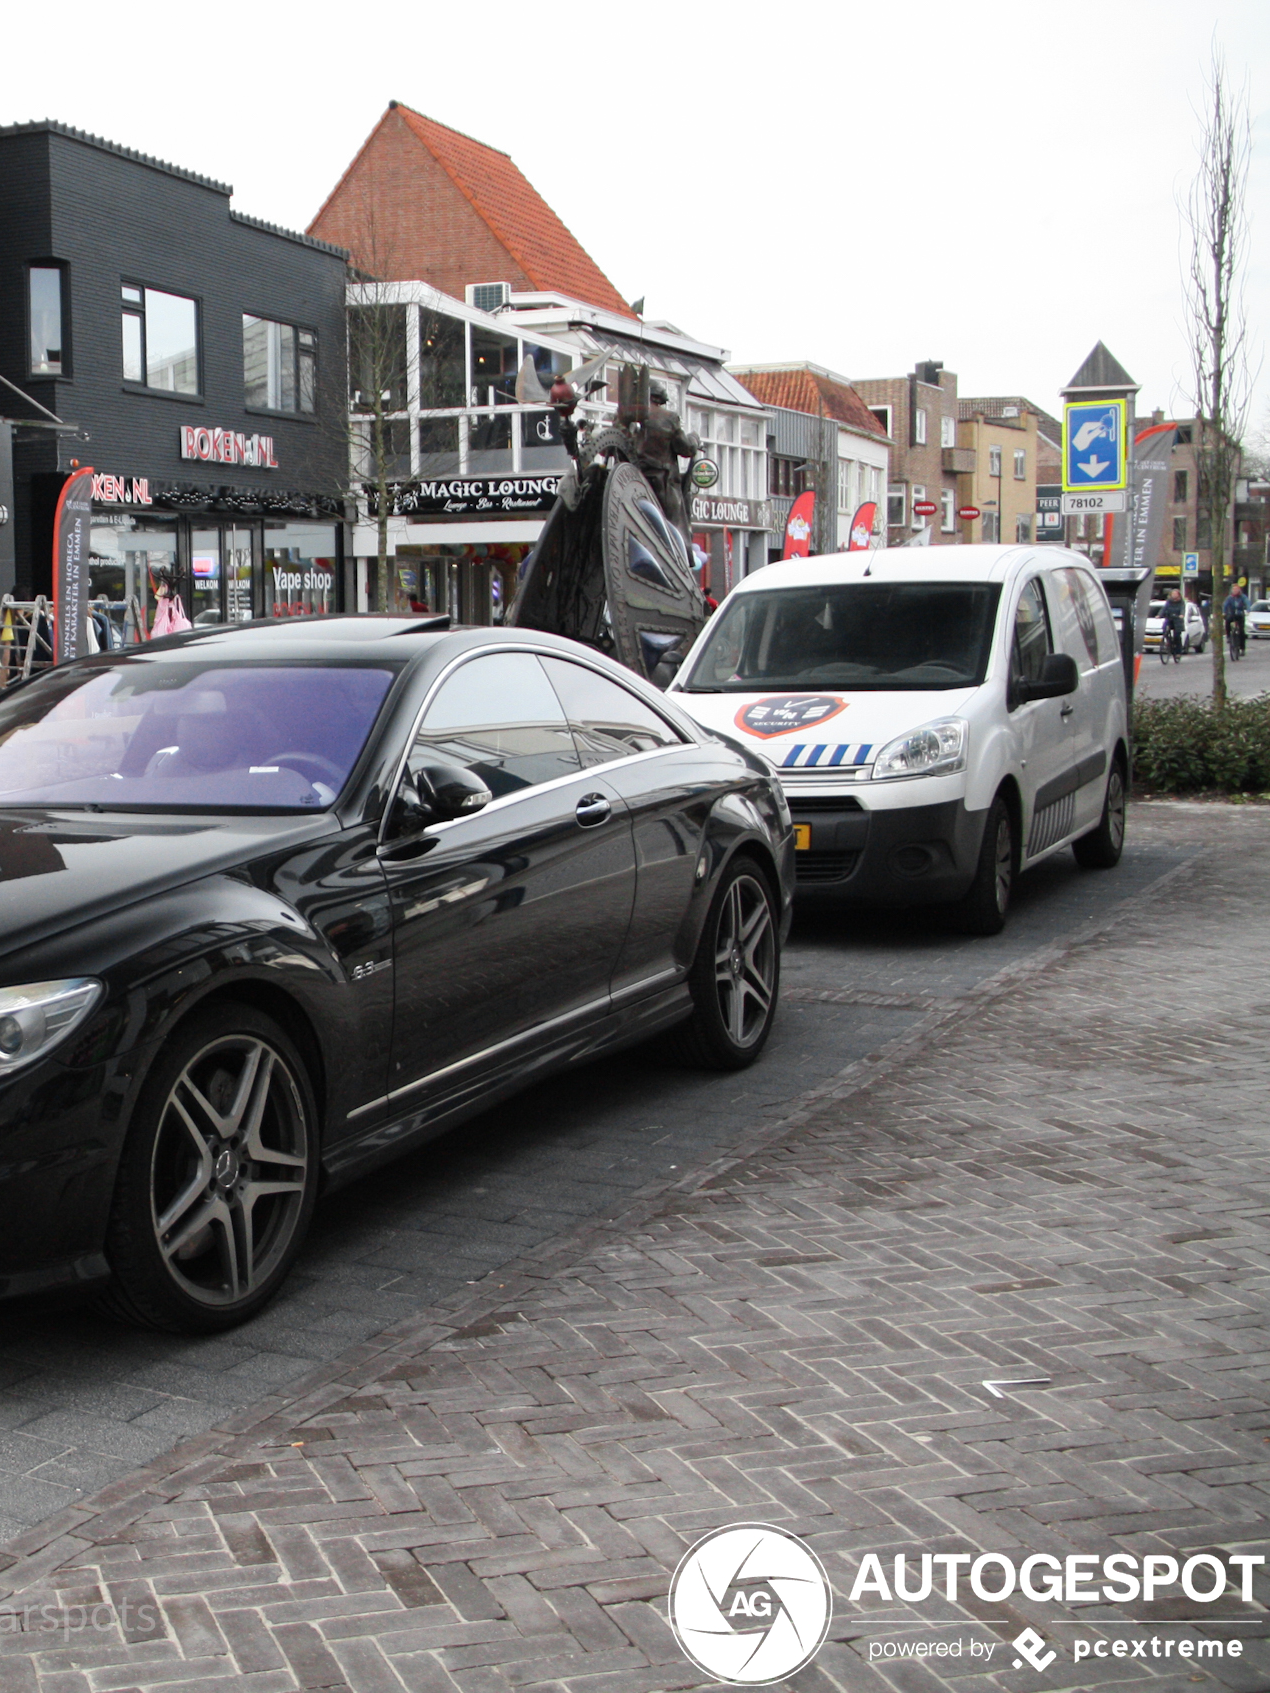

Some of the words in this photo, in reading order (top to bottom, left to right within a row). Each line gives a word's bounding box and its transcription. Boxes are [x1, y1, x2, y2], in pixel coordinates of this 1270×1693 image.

[90, 472, 125, 503] KEN
[420, 481, 483, 499] MAGIC
[1138, 478, 1153, 524] EMMEN
[691, 497, 711, 521] GIC
[711, 502, 749, 523] LOUNGE
[1070, 498, 1103, 508] 78102
[73, 517, 82, 561] EMMEN
[66, 532, 74, 582] HORECA
[72, 568, 80, 579] IN
[194, 579, 219, 590] WELKOM
[228, 579, 251, 590] WLKOM
[272, 566, 301, 595] Vape
[304, 567, 331, 595] shop
[66, 588, 72, 601] EN
[70, 582, 79, 644] KARAKTER
[63, 605, 72, 657] WINKELS
